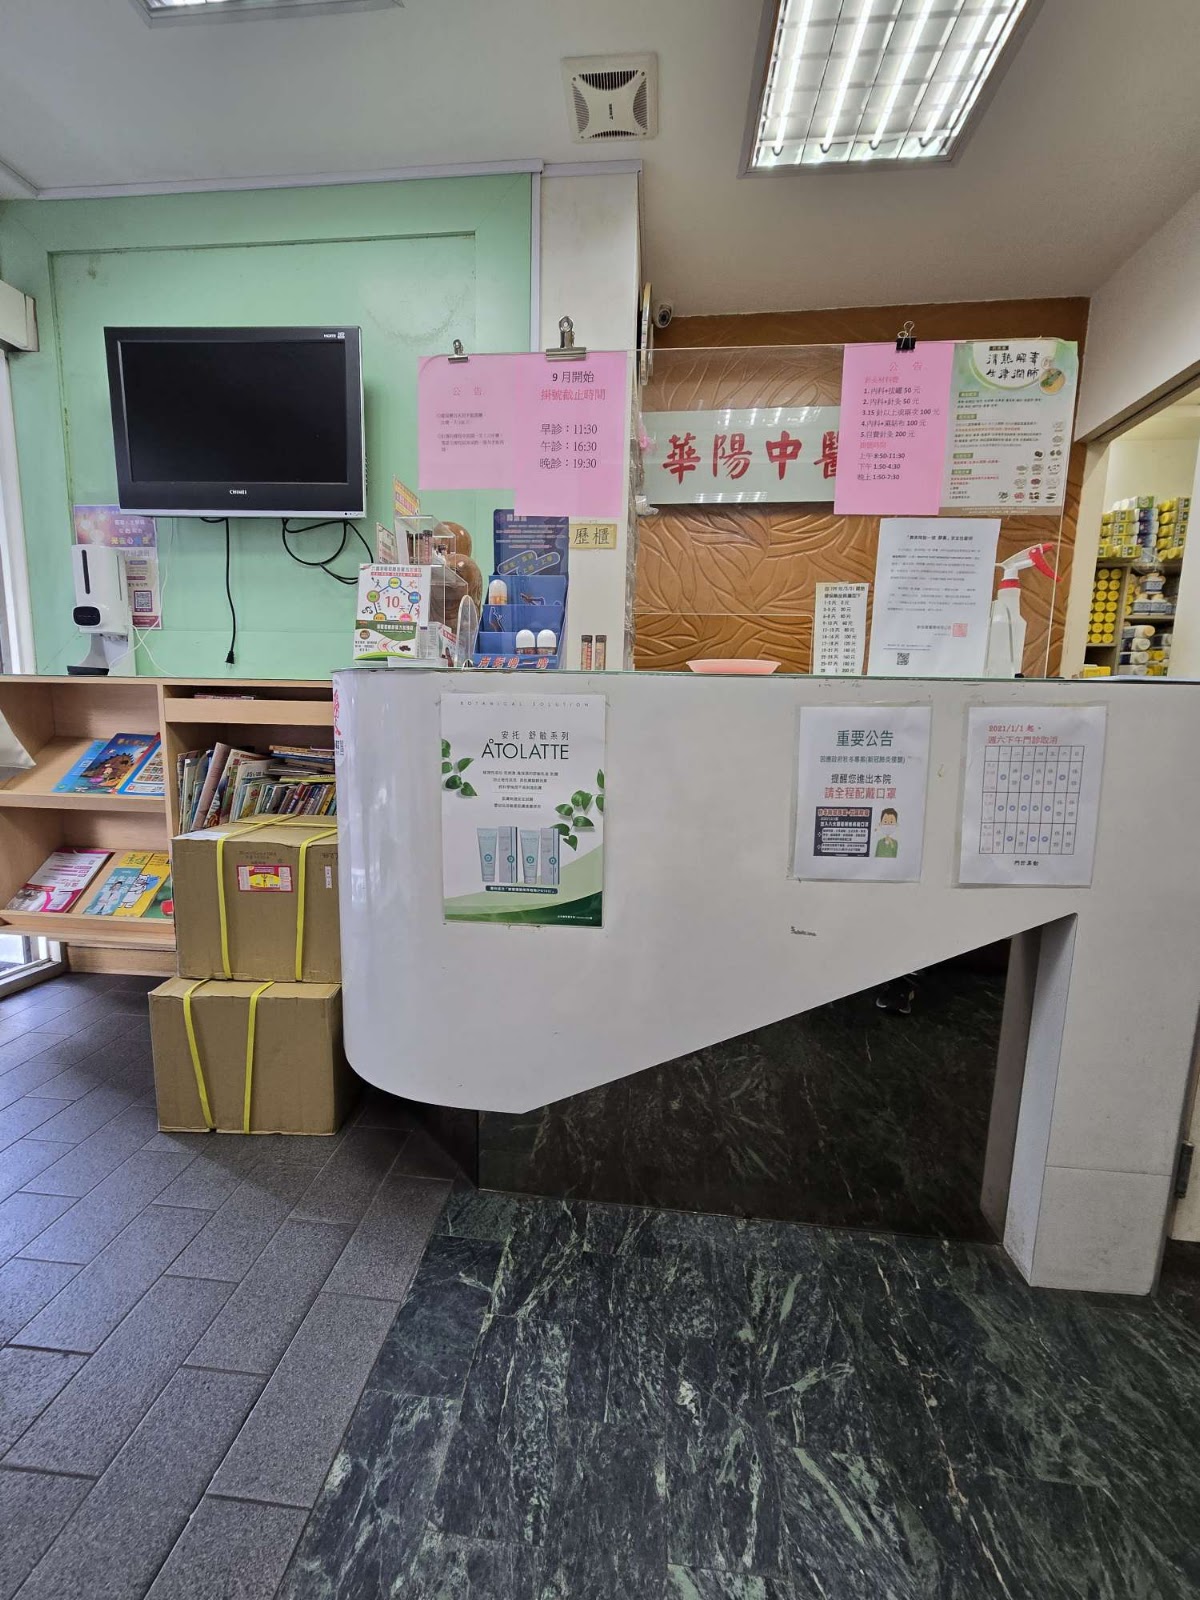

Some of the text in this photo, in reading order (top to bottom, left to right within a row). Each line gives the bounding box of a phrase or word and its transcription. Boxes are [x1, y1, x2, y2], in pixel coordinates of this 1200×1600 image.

[561, 371, 594, 383] 月開始
[986, 367, 1039, 380] 生津潤肺
[540, 388, 606, 401] 掛號截止時間
[662, 430, 839, 485] 華陽中醫
[385, 595, 400, 608] 10
[988, 724, 1024, 732] 2021/1/1
[501, 730, 570, 741] 安托 舒敏系列
[836, 729, 894, 747] 重要公告
[988, 735, 1058, 745] 週六下午門診取消
[831, 773, 892, 785] 提醒您進出本院
[824, 787, 897, 800] 請全程配戴口罩
